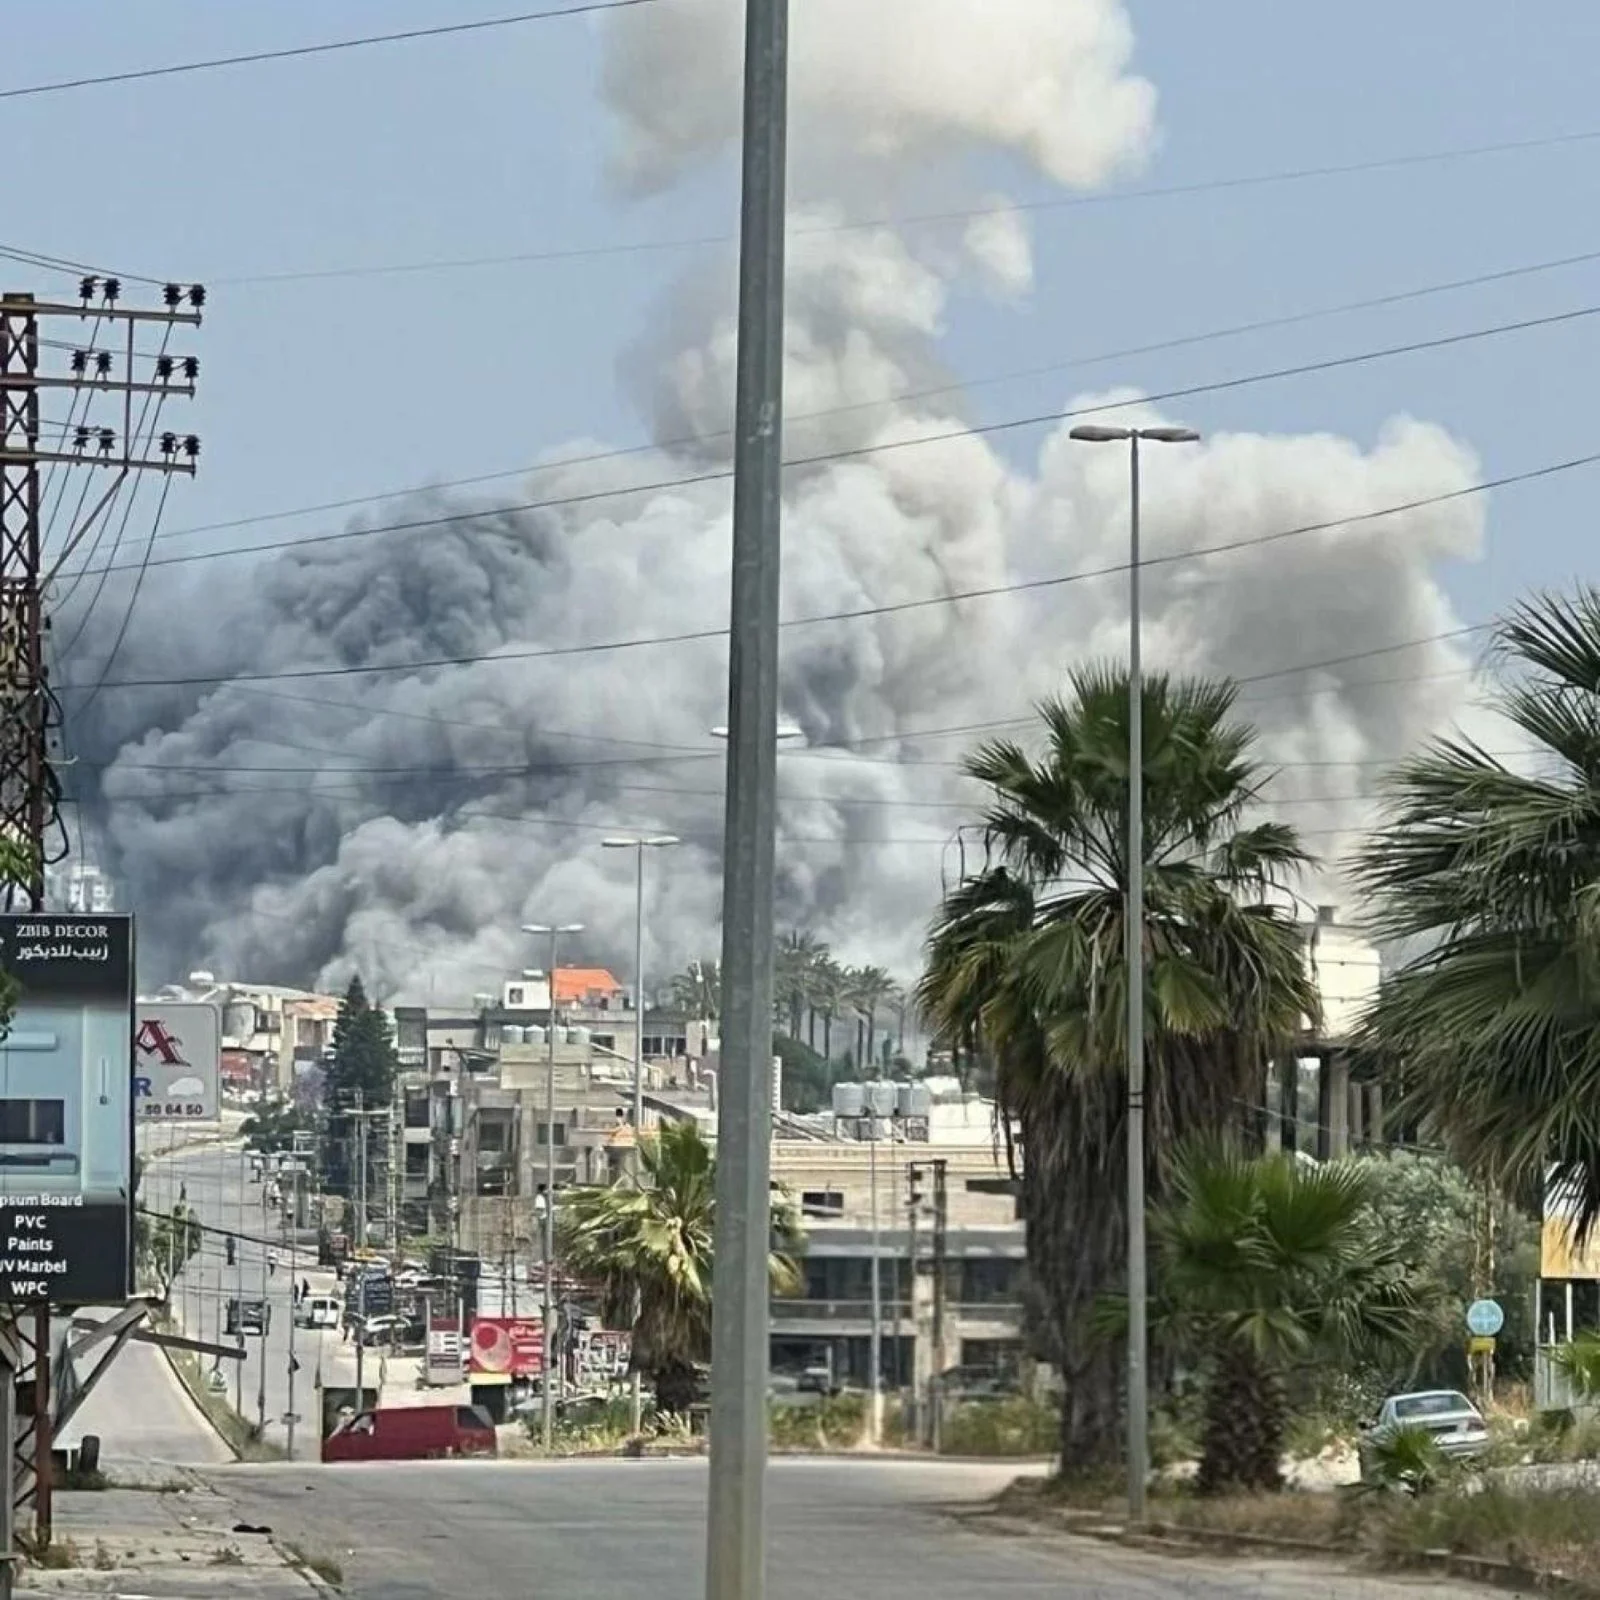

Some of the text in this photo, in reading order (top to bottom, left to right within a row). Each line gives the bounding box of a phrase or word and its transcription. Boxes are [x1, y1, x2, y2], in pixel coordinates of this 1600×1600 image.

[16, 924, 108, 937] ZBIB DECOR
[16, 944, 71, 960] للديكور
[40, 1193, 83, 1206] Board
[15, 1215, 47, 1229] PVC
[8, 1236, 53, 1251] Paints
[17, 1259, 67, 1274] Marbel
[11, 1280, 48, 1295] WPC
